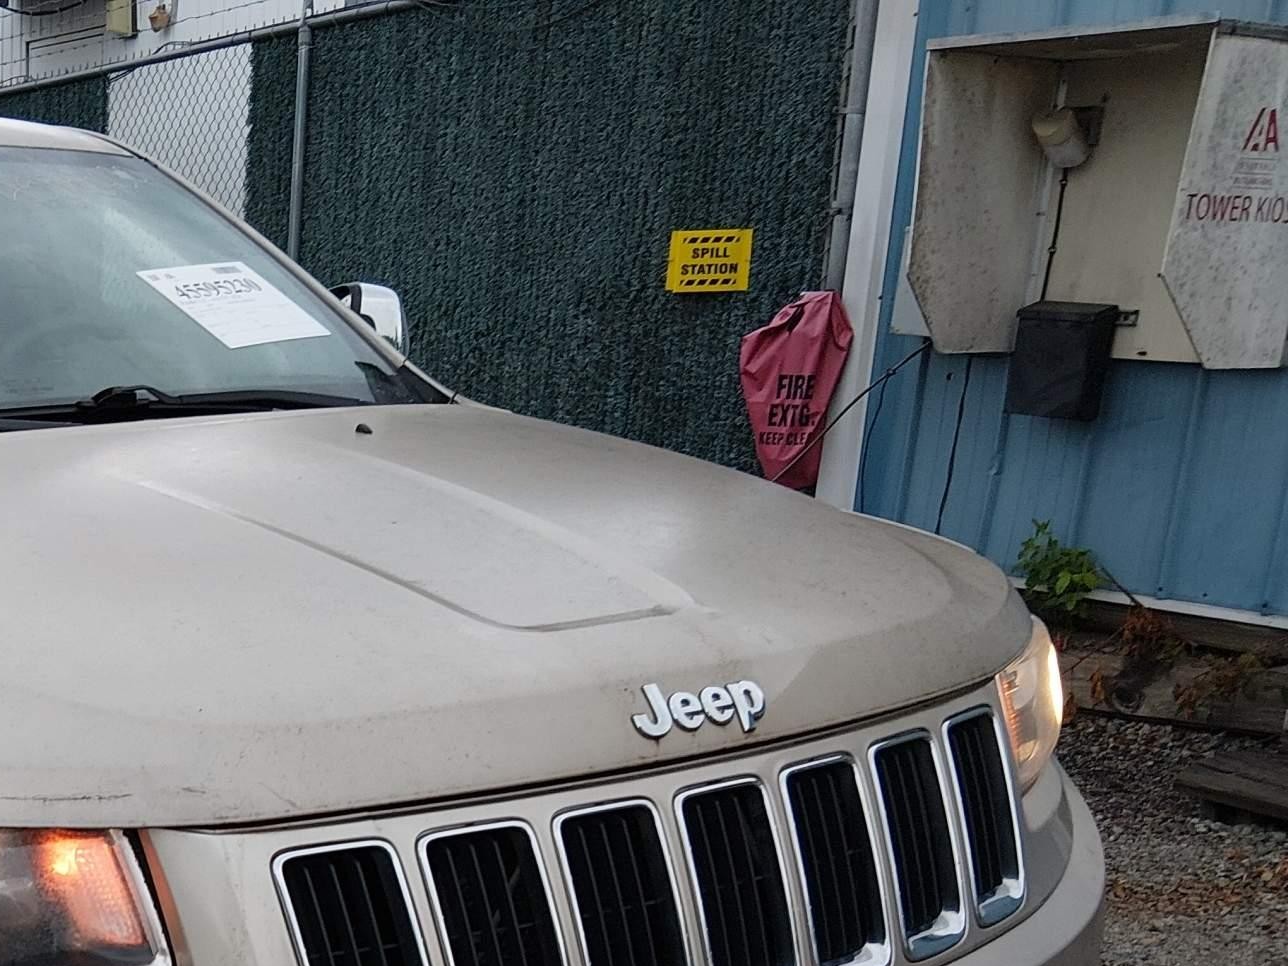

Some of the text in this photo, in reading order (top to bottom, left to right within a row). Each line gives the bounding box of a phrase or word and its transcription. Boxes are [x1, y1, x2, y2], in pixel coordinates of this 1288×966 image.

[1185, 193, 1253, 222] TOWER
[691, 247, 731, 259] SPILL
[680, 262, 739, 276] STATION
[174, 277, 262, 299] 45595230
[775, 373, 817, 400] FIRE
[758, 431, 785, 446] KEEP
[632, 680, 766, 738] Jeep
